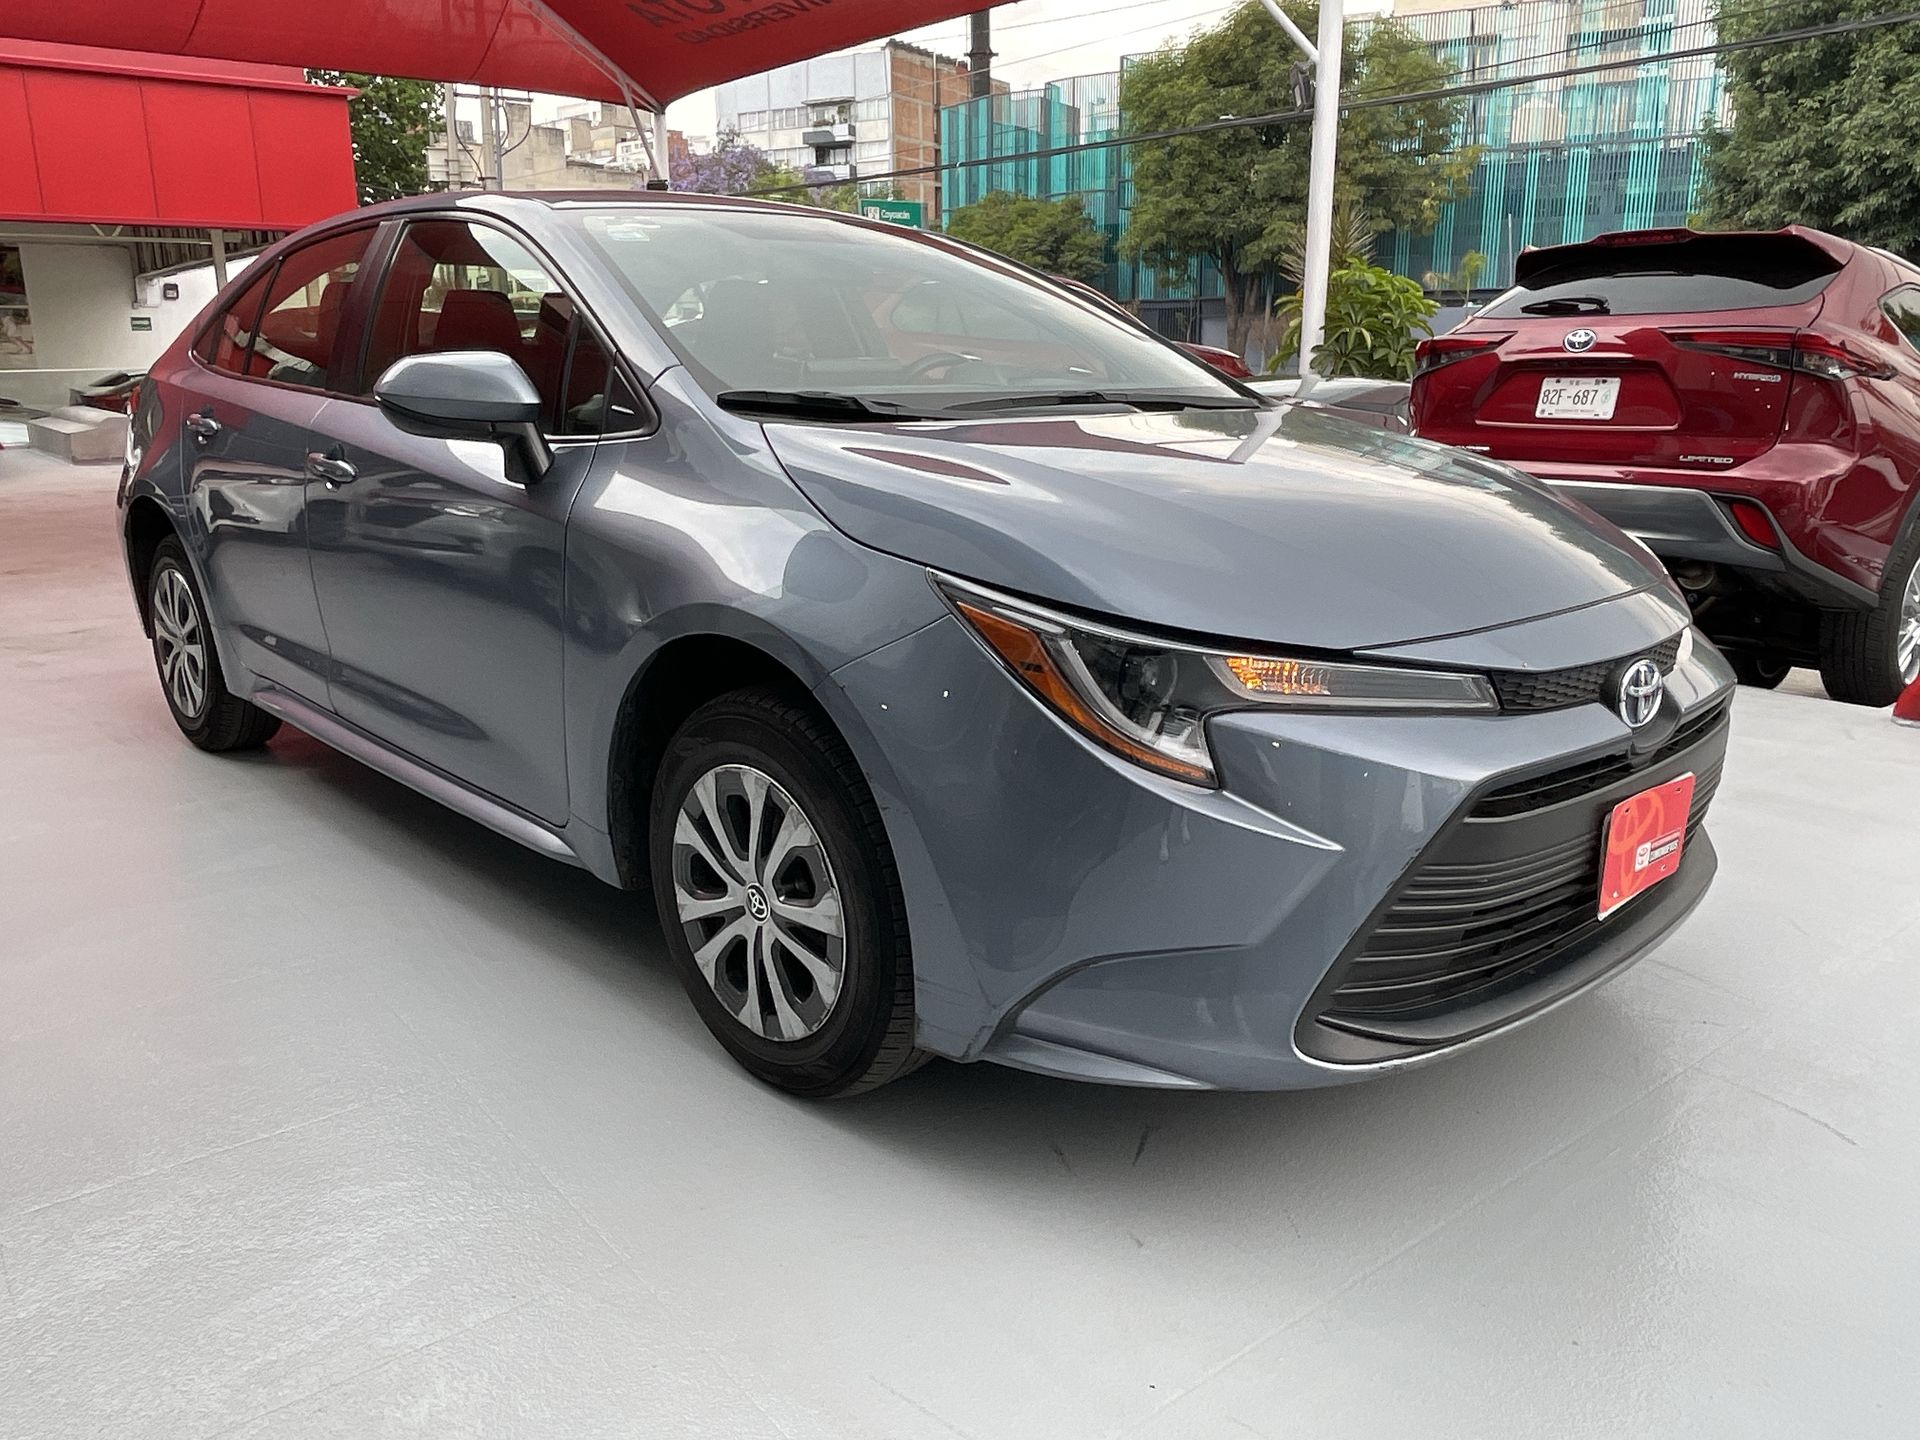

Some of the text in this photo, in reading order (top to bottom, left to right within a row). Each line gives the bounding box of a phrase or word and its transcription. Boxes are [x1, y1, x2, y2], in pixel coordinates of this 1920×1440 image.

[1733, 372, 1781, 382] HYBRID
[1541, 388, 1599, 405] 82F-687
[1679, 455, 1733, 464] LIMITED
